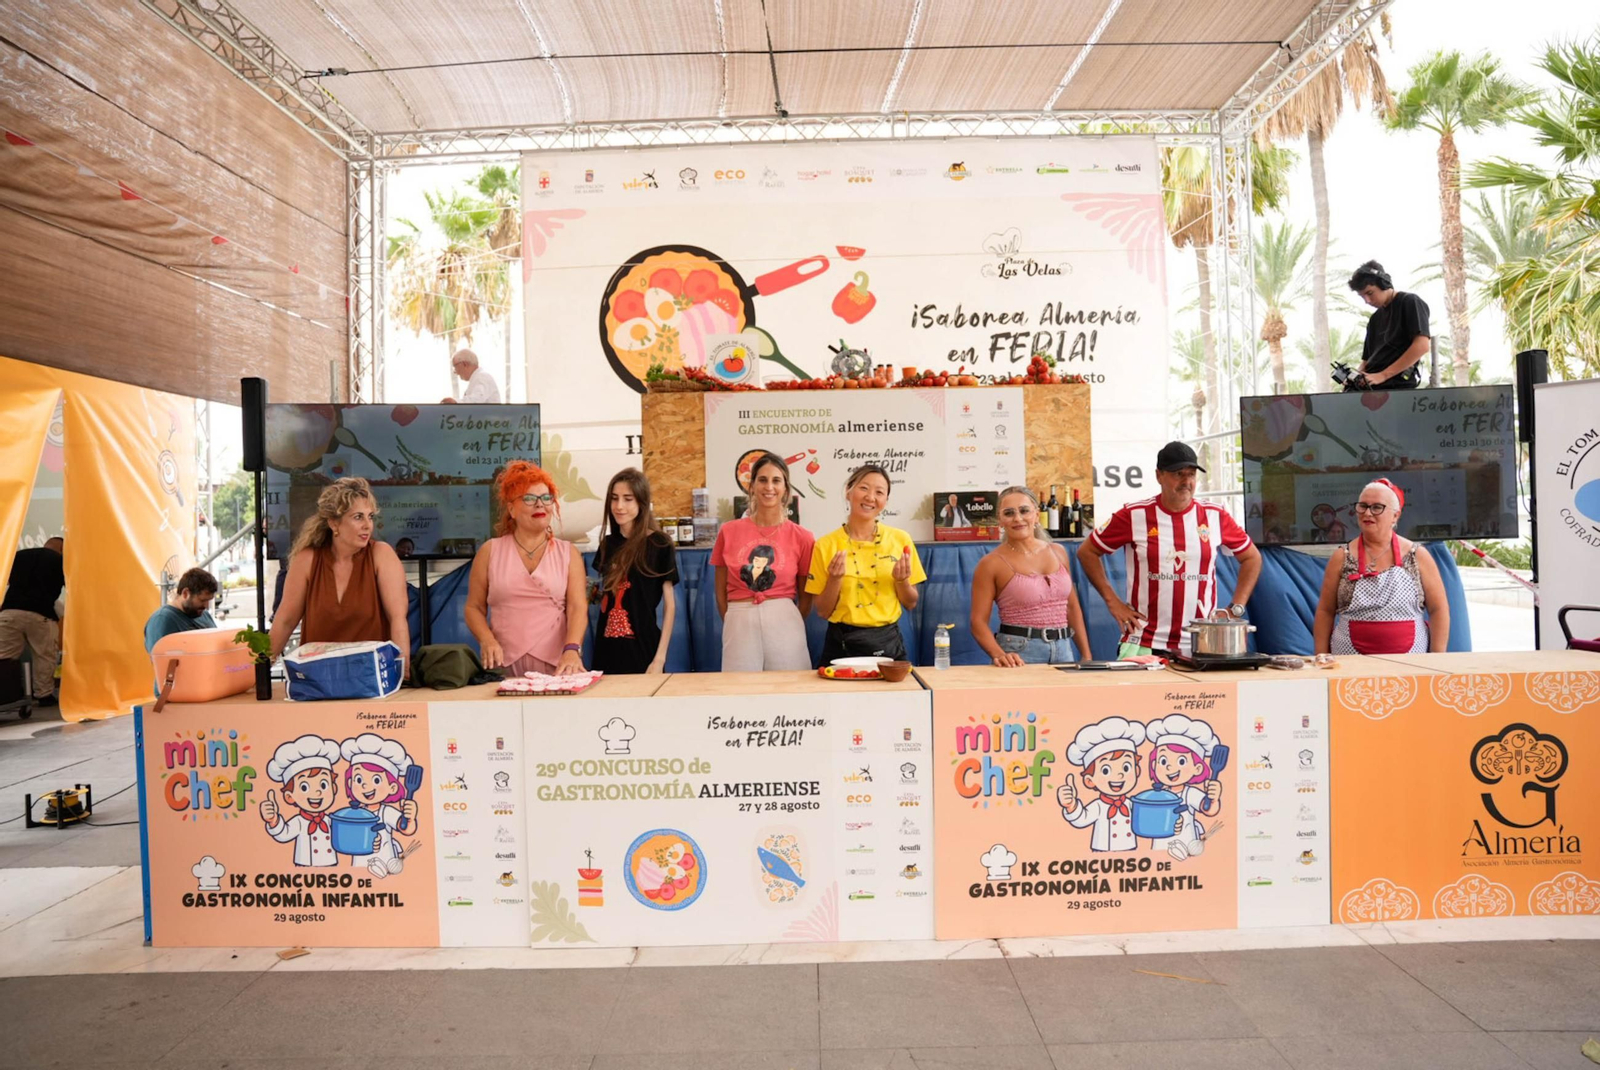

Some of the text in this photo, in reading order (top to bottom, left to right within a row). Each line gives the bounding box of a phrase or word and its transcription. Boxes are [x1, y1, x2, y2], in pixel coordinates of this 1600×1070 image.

[714, 170, 745, 180] eco
[998, 262, 1062, 280] Las Velas
[911, 301, 1141, 329] ¡Saborea Almería
[947, 347, 978, 365] en
[738, 408, 832, 419] III ENCUENTRO DE
[440, 414, 510, 430] ¡Saborea
[738, 420, 924, 436] GASTRONOMÍA almeriense
[1436, 422, 1456, 435] en
[462, 432, 540, 452] en FERI
[1440, 439, 1454, 448] del
[1469, 438, 1478, 446] al
[1556, 428, 1599, 476] EL TOM
[466, 456, 479, 465] del
[494, 456, 502, 464] al
[1148, 571, 1180, 580] Arabian
[1185, 700, 1214, 710] FERIA!
[376, 720, 406, 729] FERIA!
[707, 715, 826, 730] ¡Saborea Almería
[725, 730, 803, 748] en FERIA!
[955, 712, 1036, 754] mini
[164, 729, 238, 769] mini
[536, 757, 711, 778] 29º CONCURSO de
[536, 779, 820, 802] GASTRONOMÍA ALMERIENSE
[1248, 782, 1271, 790] eco
[443, 802, 467, 810] eco
[847, 794, 872, 803] eco
[738, 801, 820, 813] 27 y 28 agosto
[1461, 820, 1581, 856] Almería
[1021, 857, 1171, 877] IX CONCURSO DE
[1532, 858, 1582, 866] Gastronómica
[230, 873, 372, 888] IX CONCURSO DE
[968, 875, 1203, 898] GASTRONOMÍA INFANTIL
[182, 889, 404, 908] GASTRONOMÍA INFANTIL
[1067, 898, 1122, 911] 29 agosto
[273, 912, 326, 924] 29 agosto
